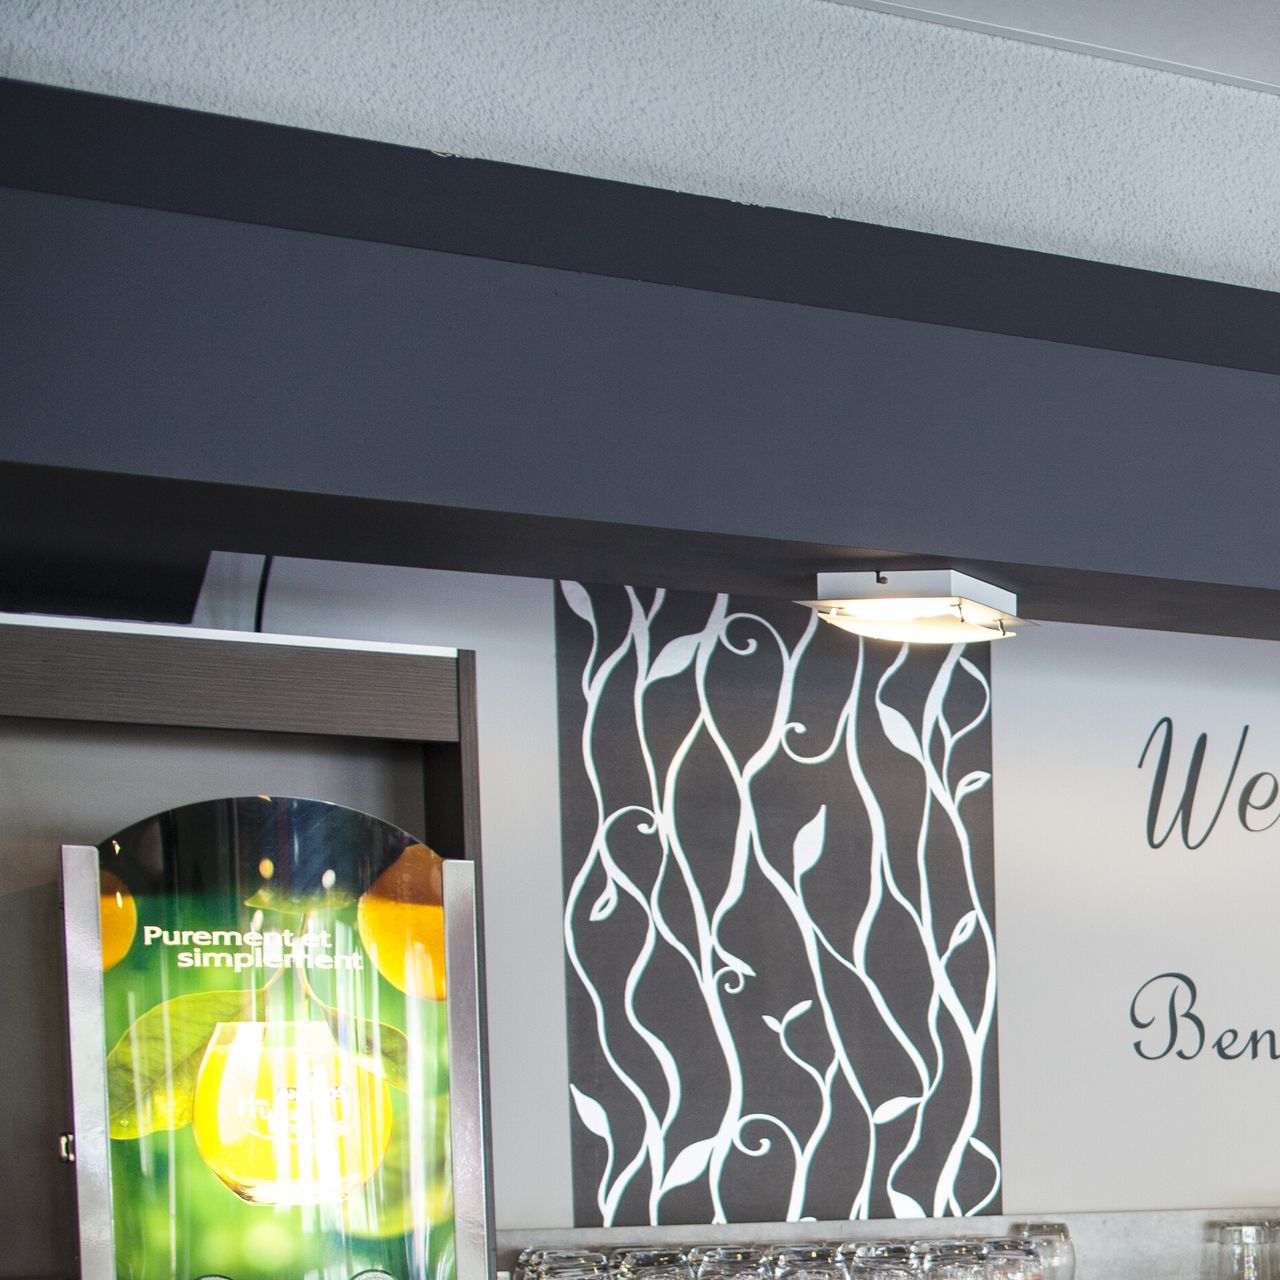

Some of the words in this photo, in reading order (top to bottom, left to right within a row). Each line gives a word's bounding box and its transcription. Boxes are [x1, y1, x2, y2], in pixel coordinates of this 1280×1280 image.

[143, 926, 294, 947] Purement
[300, 929, 333, 948] et
[177, 948, 364, 973] simplement
